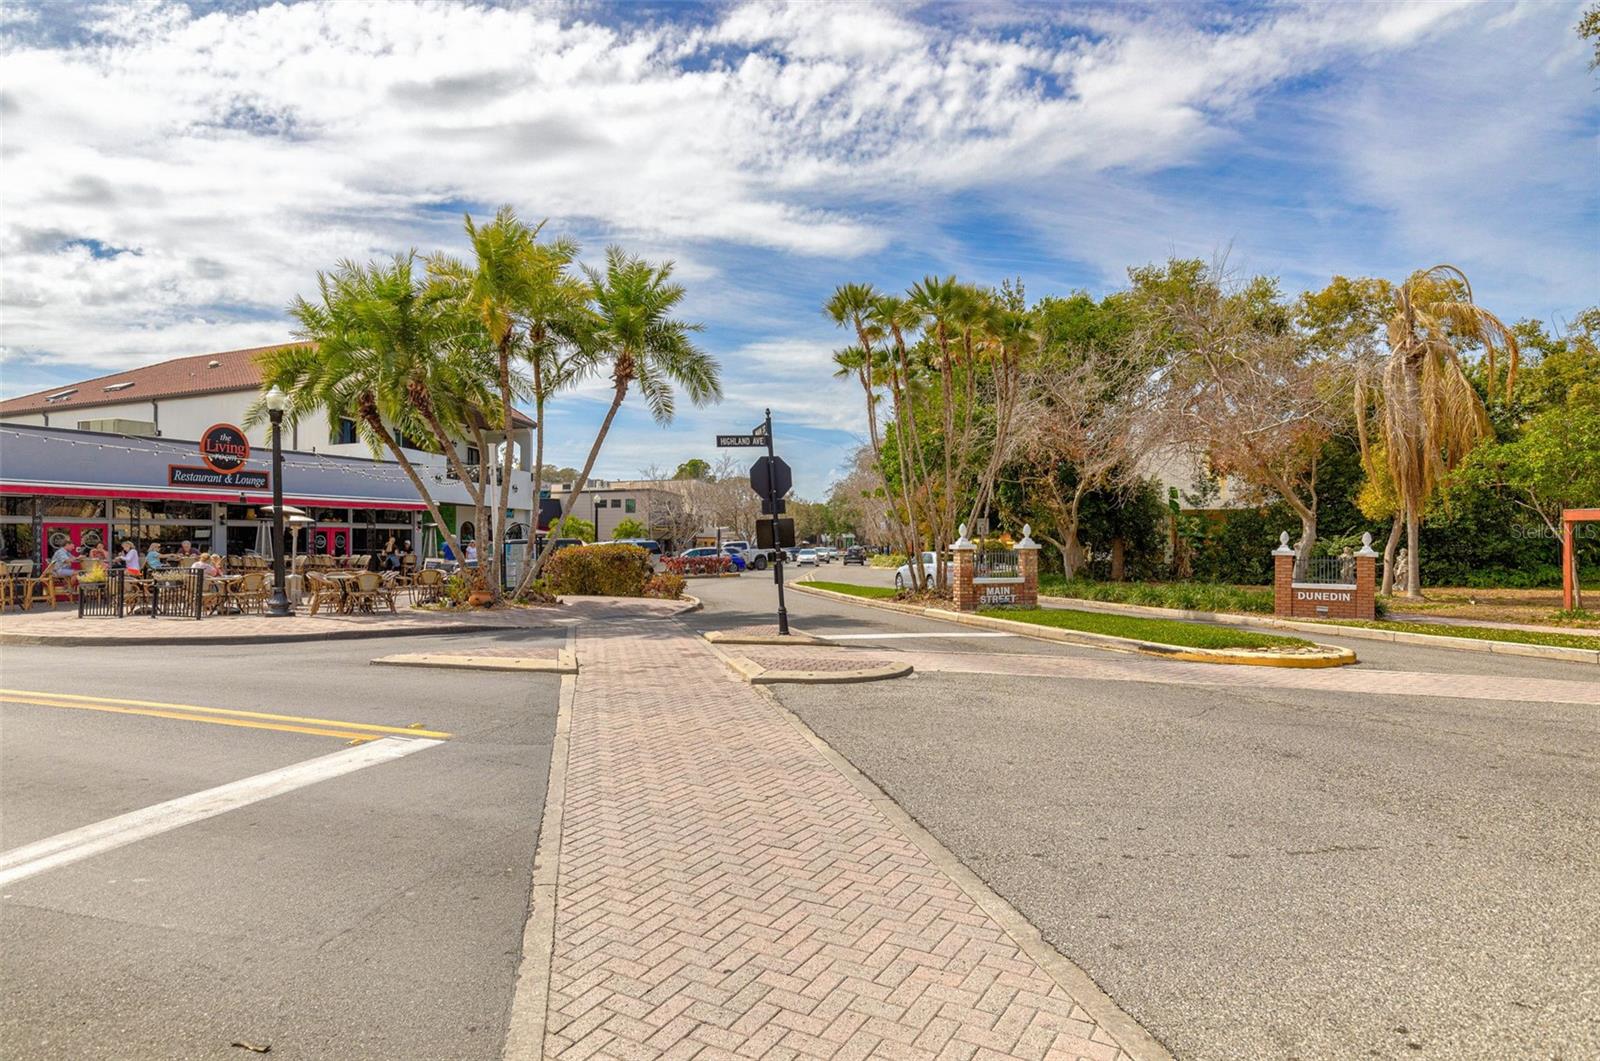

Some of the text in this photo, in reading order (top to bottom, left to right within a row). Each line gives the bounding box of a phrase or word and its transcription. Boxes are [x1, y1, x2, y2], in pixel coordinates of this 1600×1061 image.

[220, 433, 232, 442] the
[720, 437, 764, 446] HIGHLAND AVE
[206, 438, 245, 458] Living
[174, 470, 266, 489] Restaurant & Lounge
[986, 587, 1010, 596] MAIN
[1297, 591, 1351, 602] DUNEDIN
[980, 594, 1016, 604] STREET
